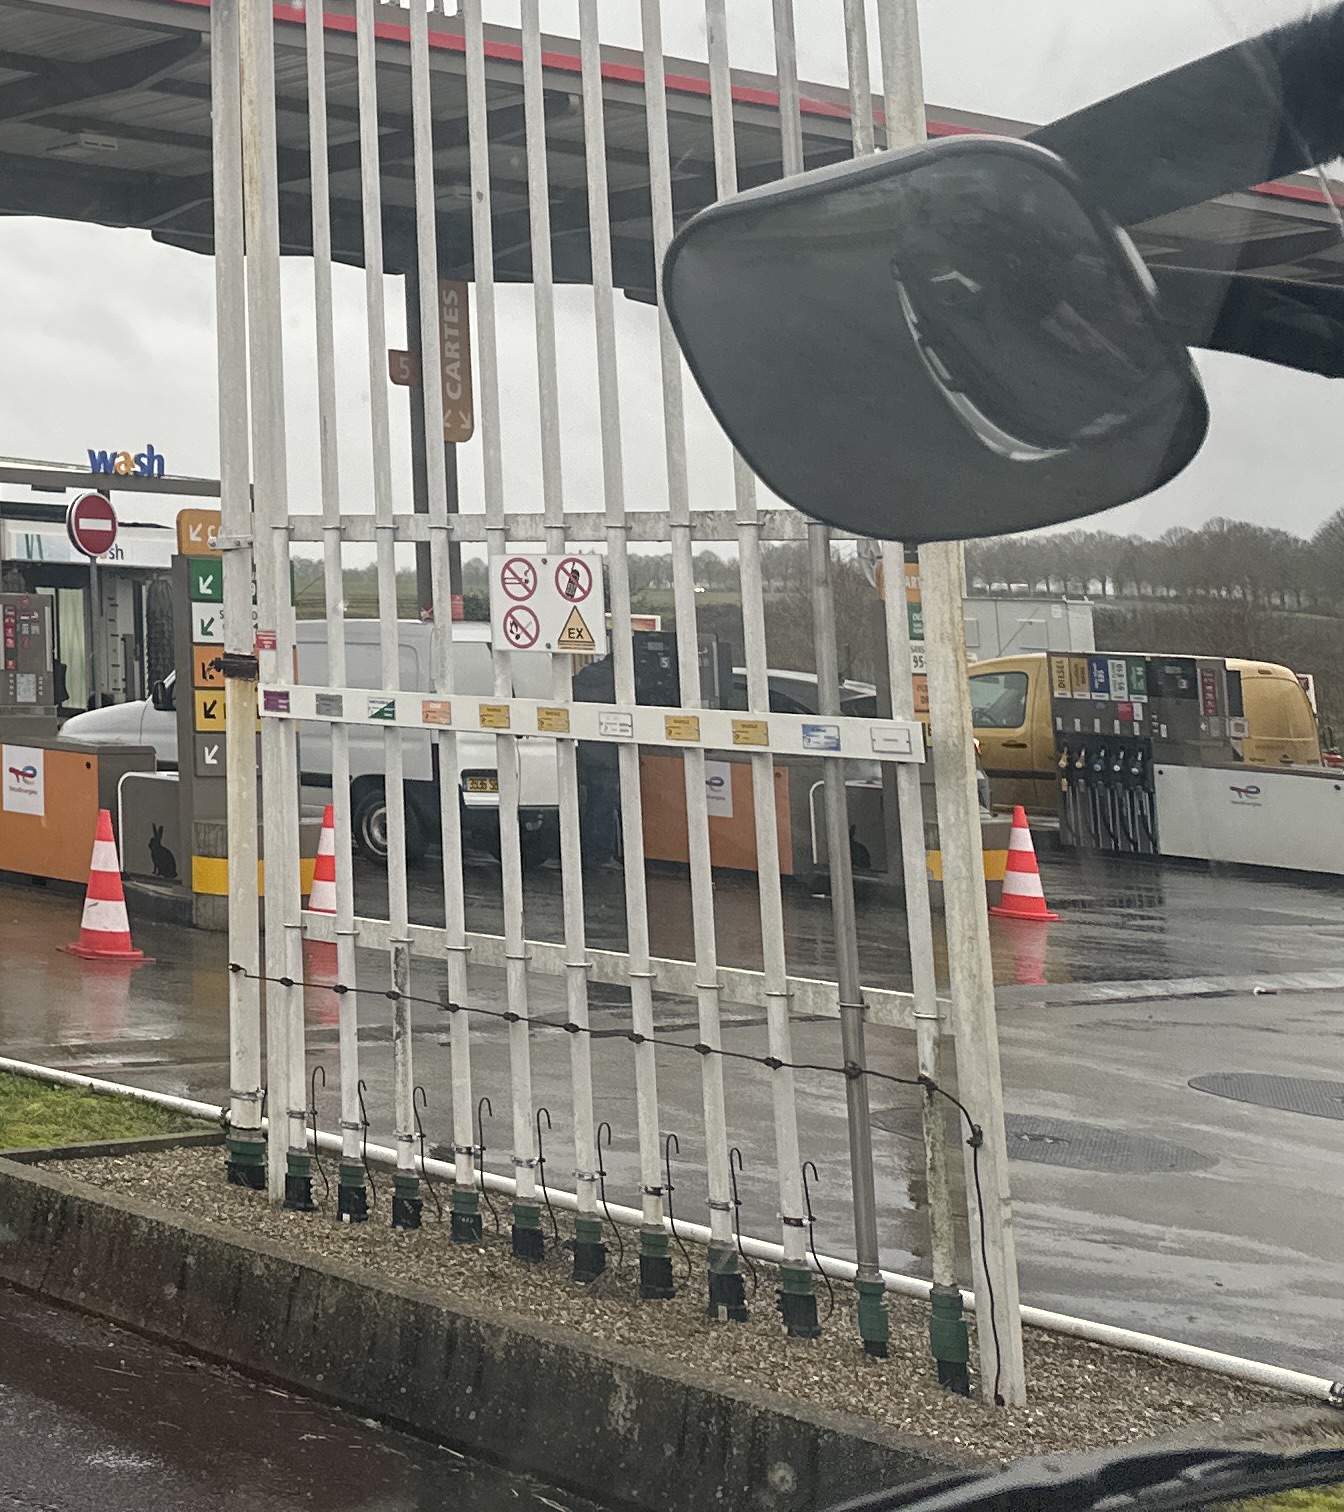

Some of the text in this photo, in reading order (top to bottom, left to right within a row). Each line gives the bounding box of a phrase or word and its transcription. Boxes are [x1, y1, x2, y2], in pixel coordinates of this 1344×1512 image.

[442, 289, 463, 400] CARTES
[400, 356, 410, 379] 5
[87, 444, 165, 478] wash
[567, 627, 584, 640] EX
